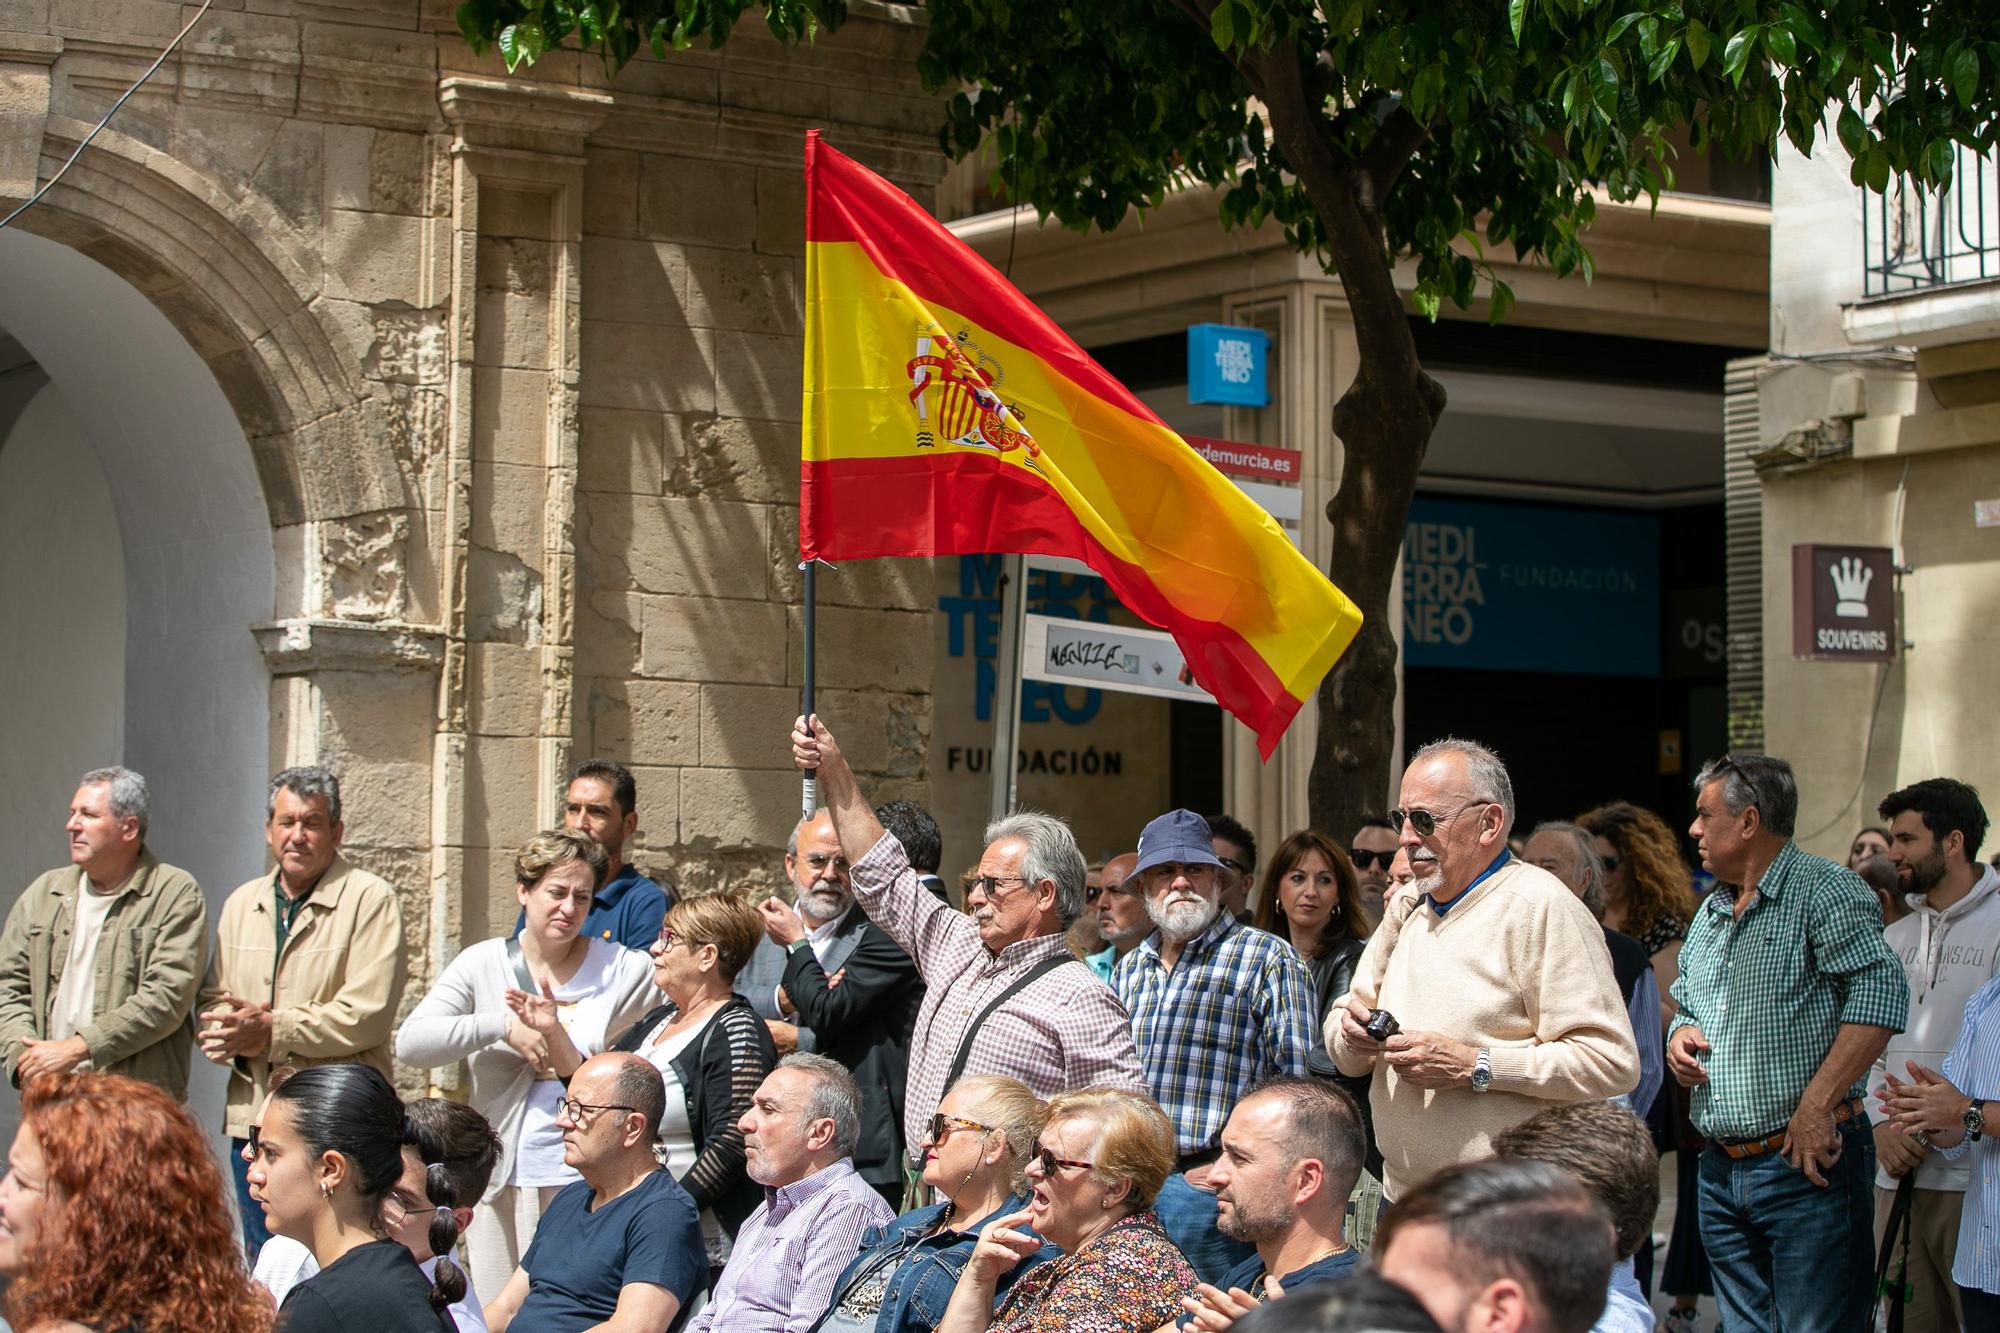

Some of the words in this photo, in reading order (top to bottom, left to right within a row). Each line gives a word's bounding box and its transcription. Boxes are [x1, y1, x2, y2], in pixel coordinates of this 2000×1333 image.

[1222, 368, 1250, 383] NEO
[1499, 562, 1638, 592] FUNDACIÓN
[1817, 628, 1887, 651] SOUVENIRS
[948, 746, 1122, 775] FUDACIÓN
